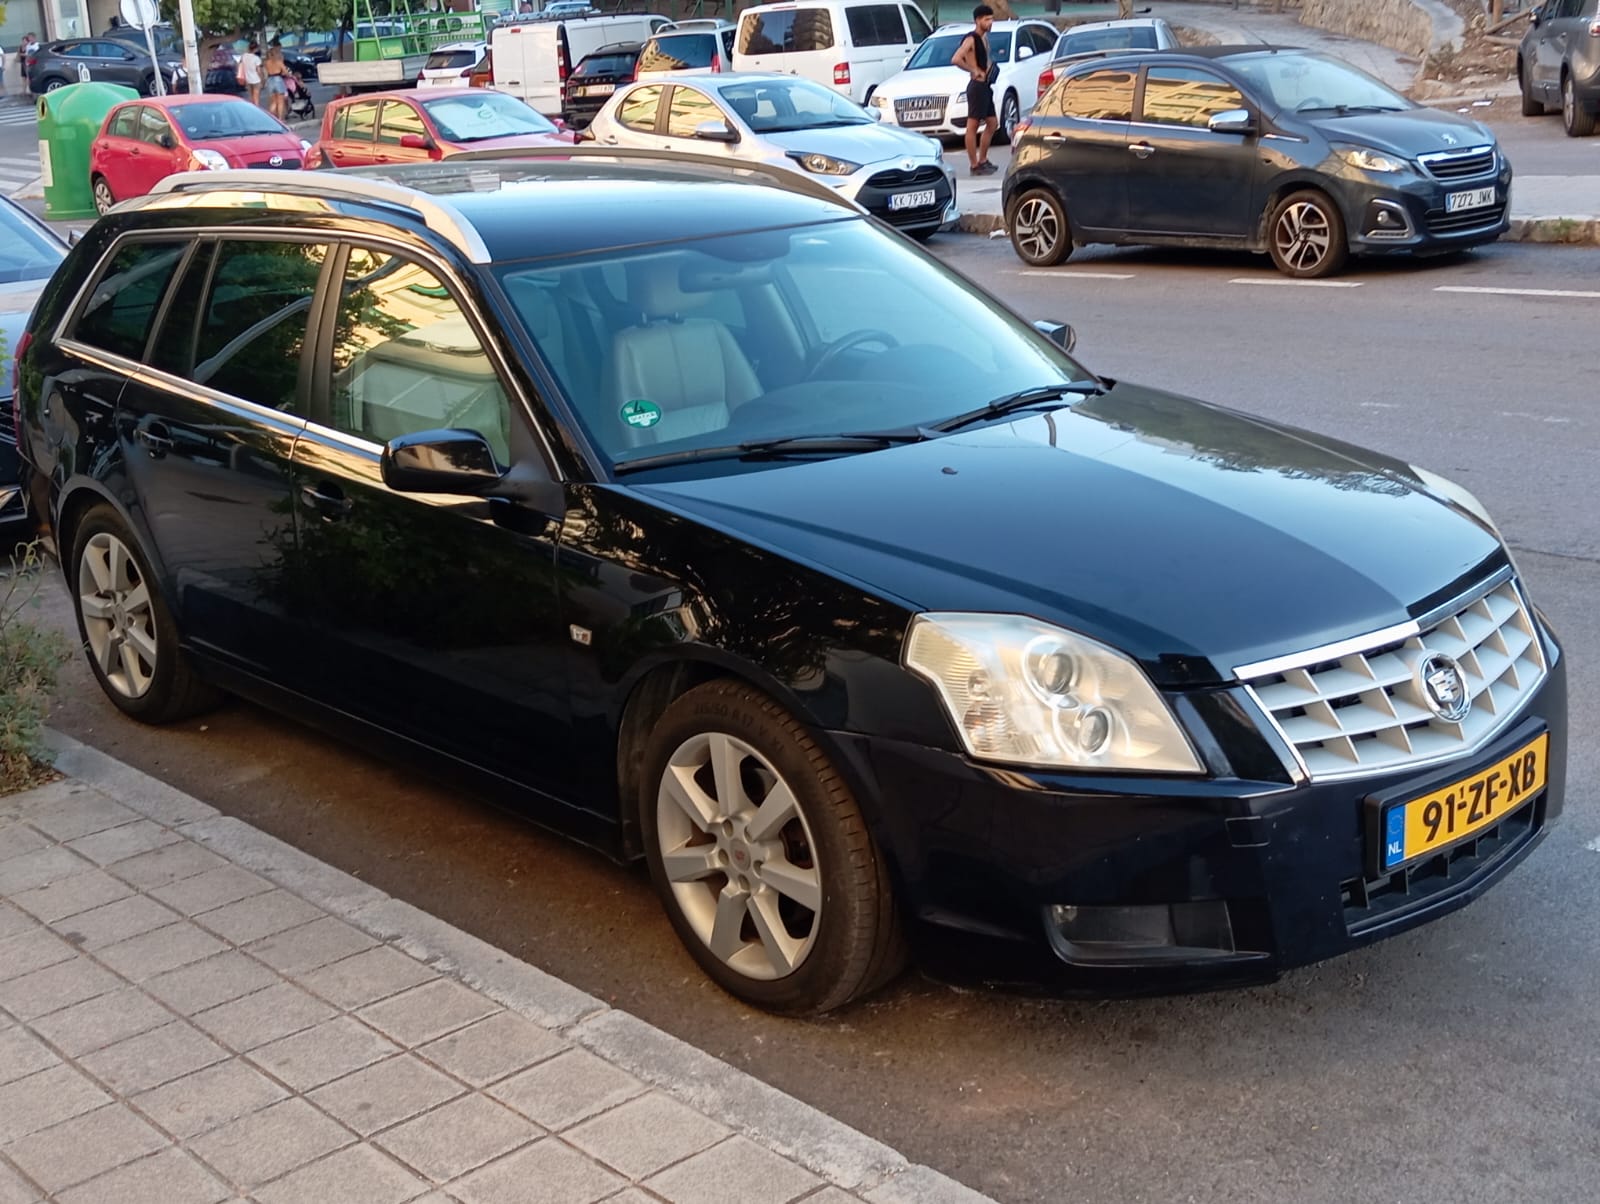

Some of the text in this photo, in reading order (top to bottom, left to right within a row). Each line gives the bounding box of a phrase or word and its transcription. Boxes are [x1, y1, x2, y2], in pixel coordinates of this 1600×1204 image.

[908, 191, 933, 206] 79357
[1452, 192, 1473, 209] 7272
[1388, 841, 1402, 857] NL
